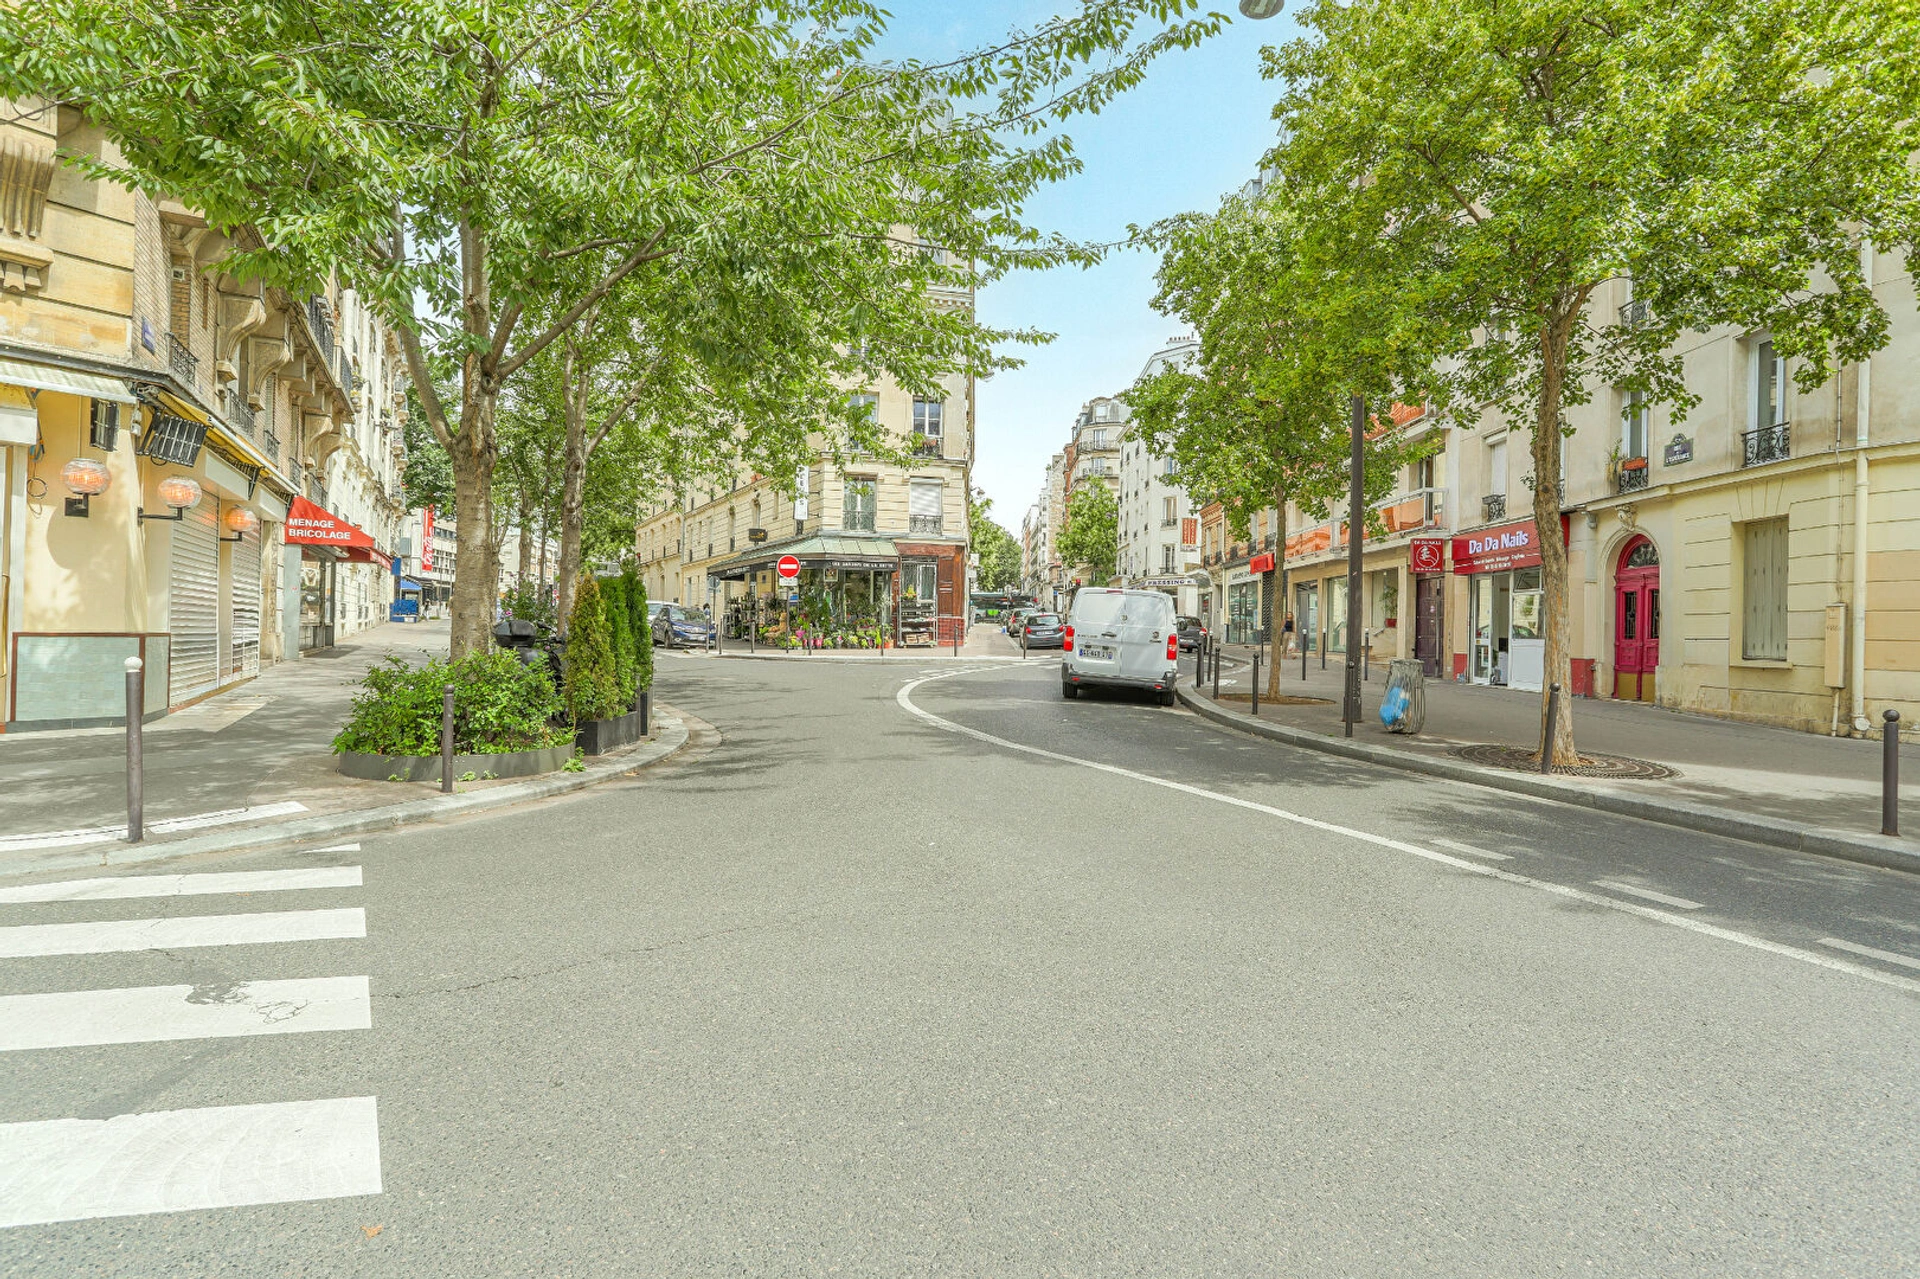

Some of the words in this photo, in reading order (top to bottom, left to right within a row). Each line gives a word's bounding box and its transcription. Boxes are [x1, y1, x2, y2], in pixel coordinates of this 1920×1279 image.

[288, 518, 335, 529] MENAGE
[288, 529, 351, 540] BRICOLAGE
[1468, 540, 1483, 555] Da
[1484, 536, 1499, 551] Da
[1501, 531, 1529, 549] Nails
